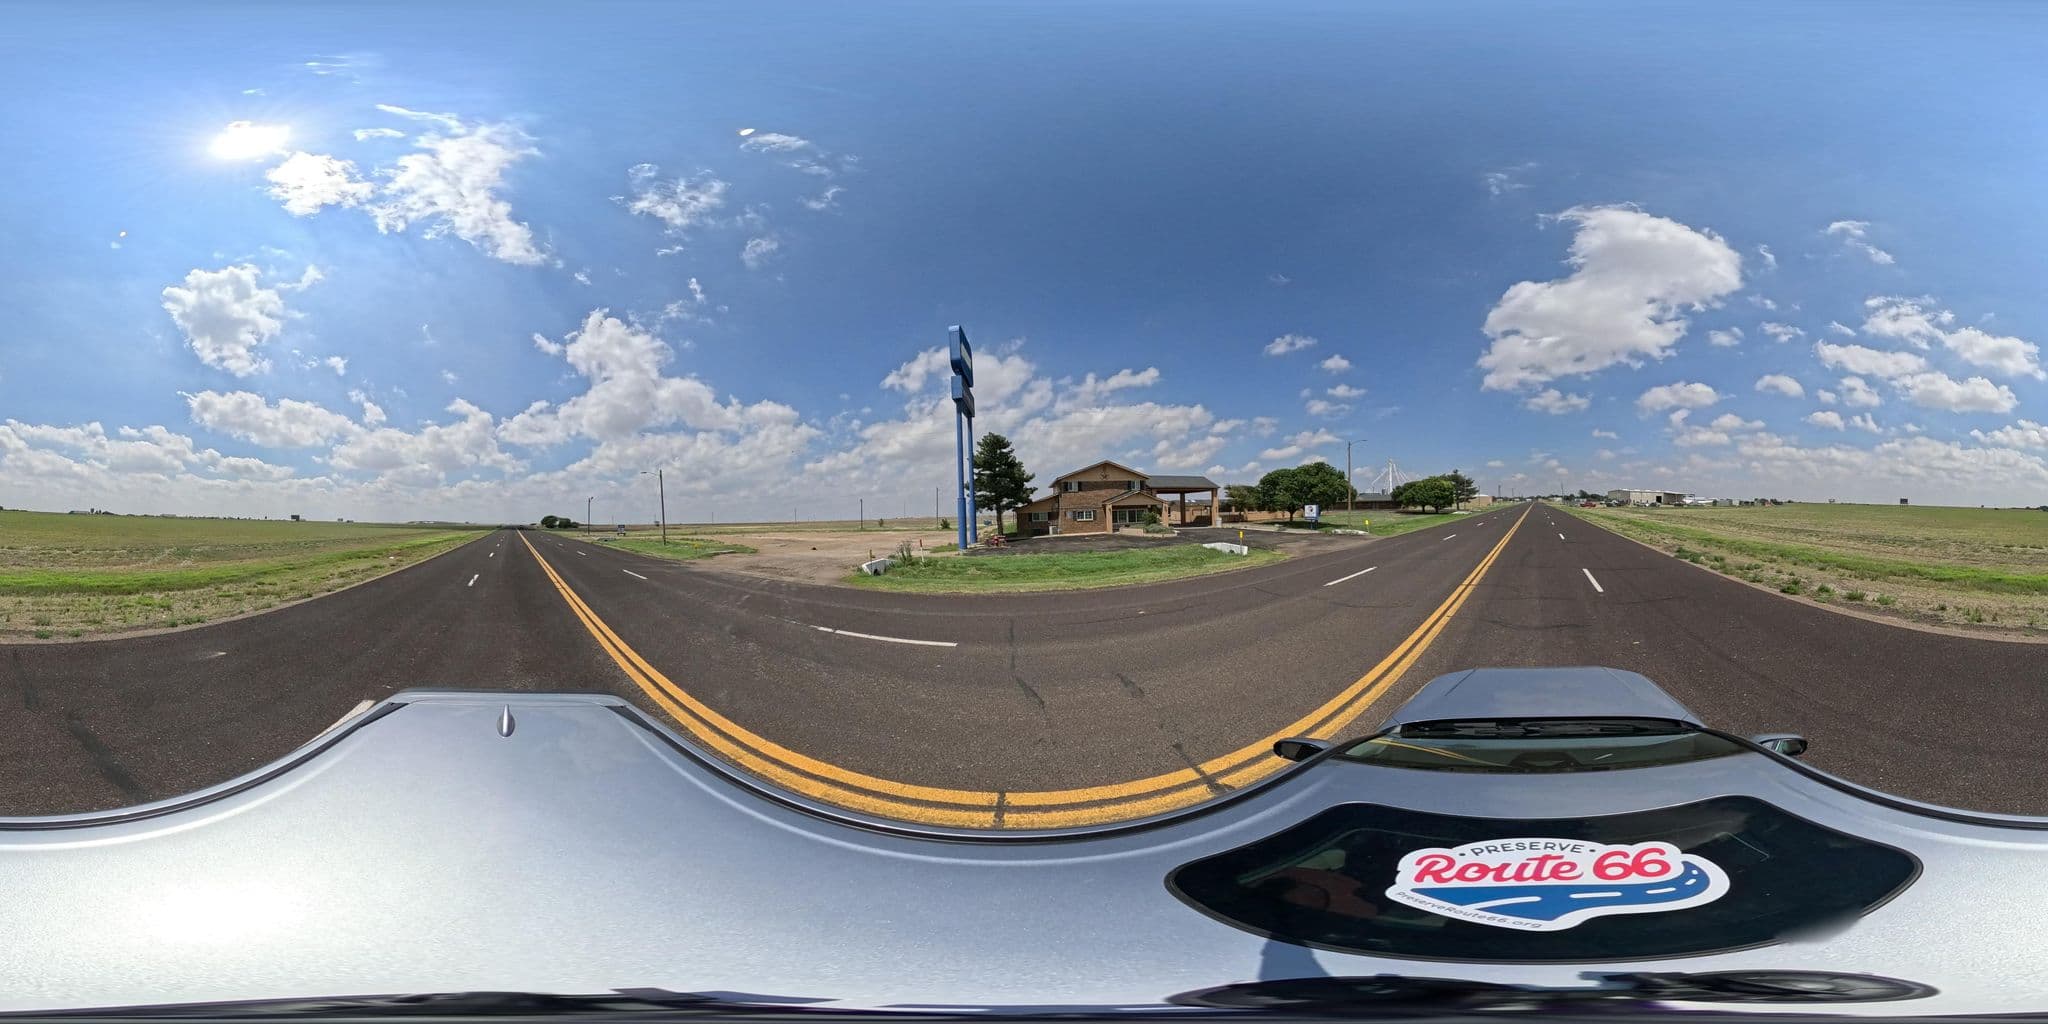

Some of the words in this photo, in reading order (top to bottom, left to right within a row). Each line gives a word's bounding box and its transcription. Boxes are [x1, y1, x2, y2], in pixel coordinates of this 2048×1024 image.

[1471, 841, 1583, 857] PRESERVE
[1414, 853, 1584, 884] Route
[1592, 847, 1672, 881] 66
